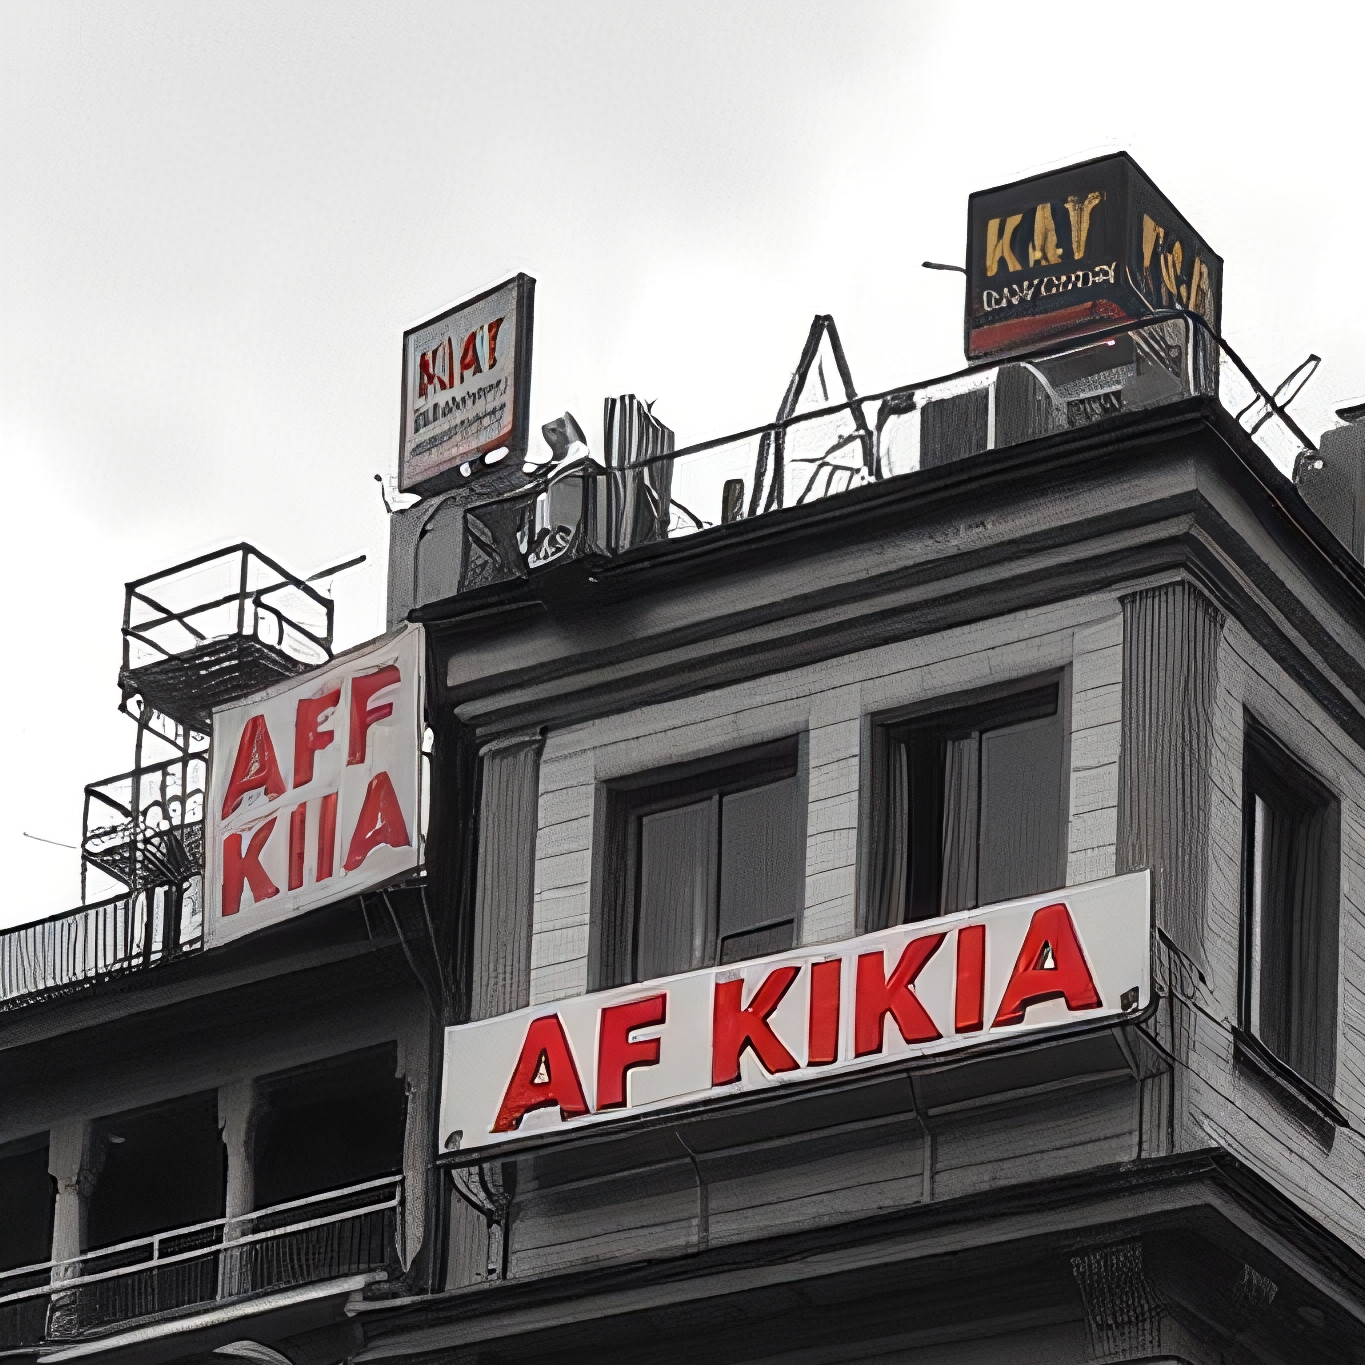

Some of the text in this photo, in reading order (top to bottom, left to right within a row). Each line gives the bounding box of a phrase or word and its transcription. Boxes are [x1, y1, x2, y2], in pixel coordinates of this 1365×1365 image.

[221, 664, 402, 820] AFF
[490, 902, 1104, 1134] AF KIKIA
